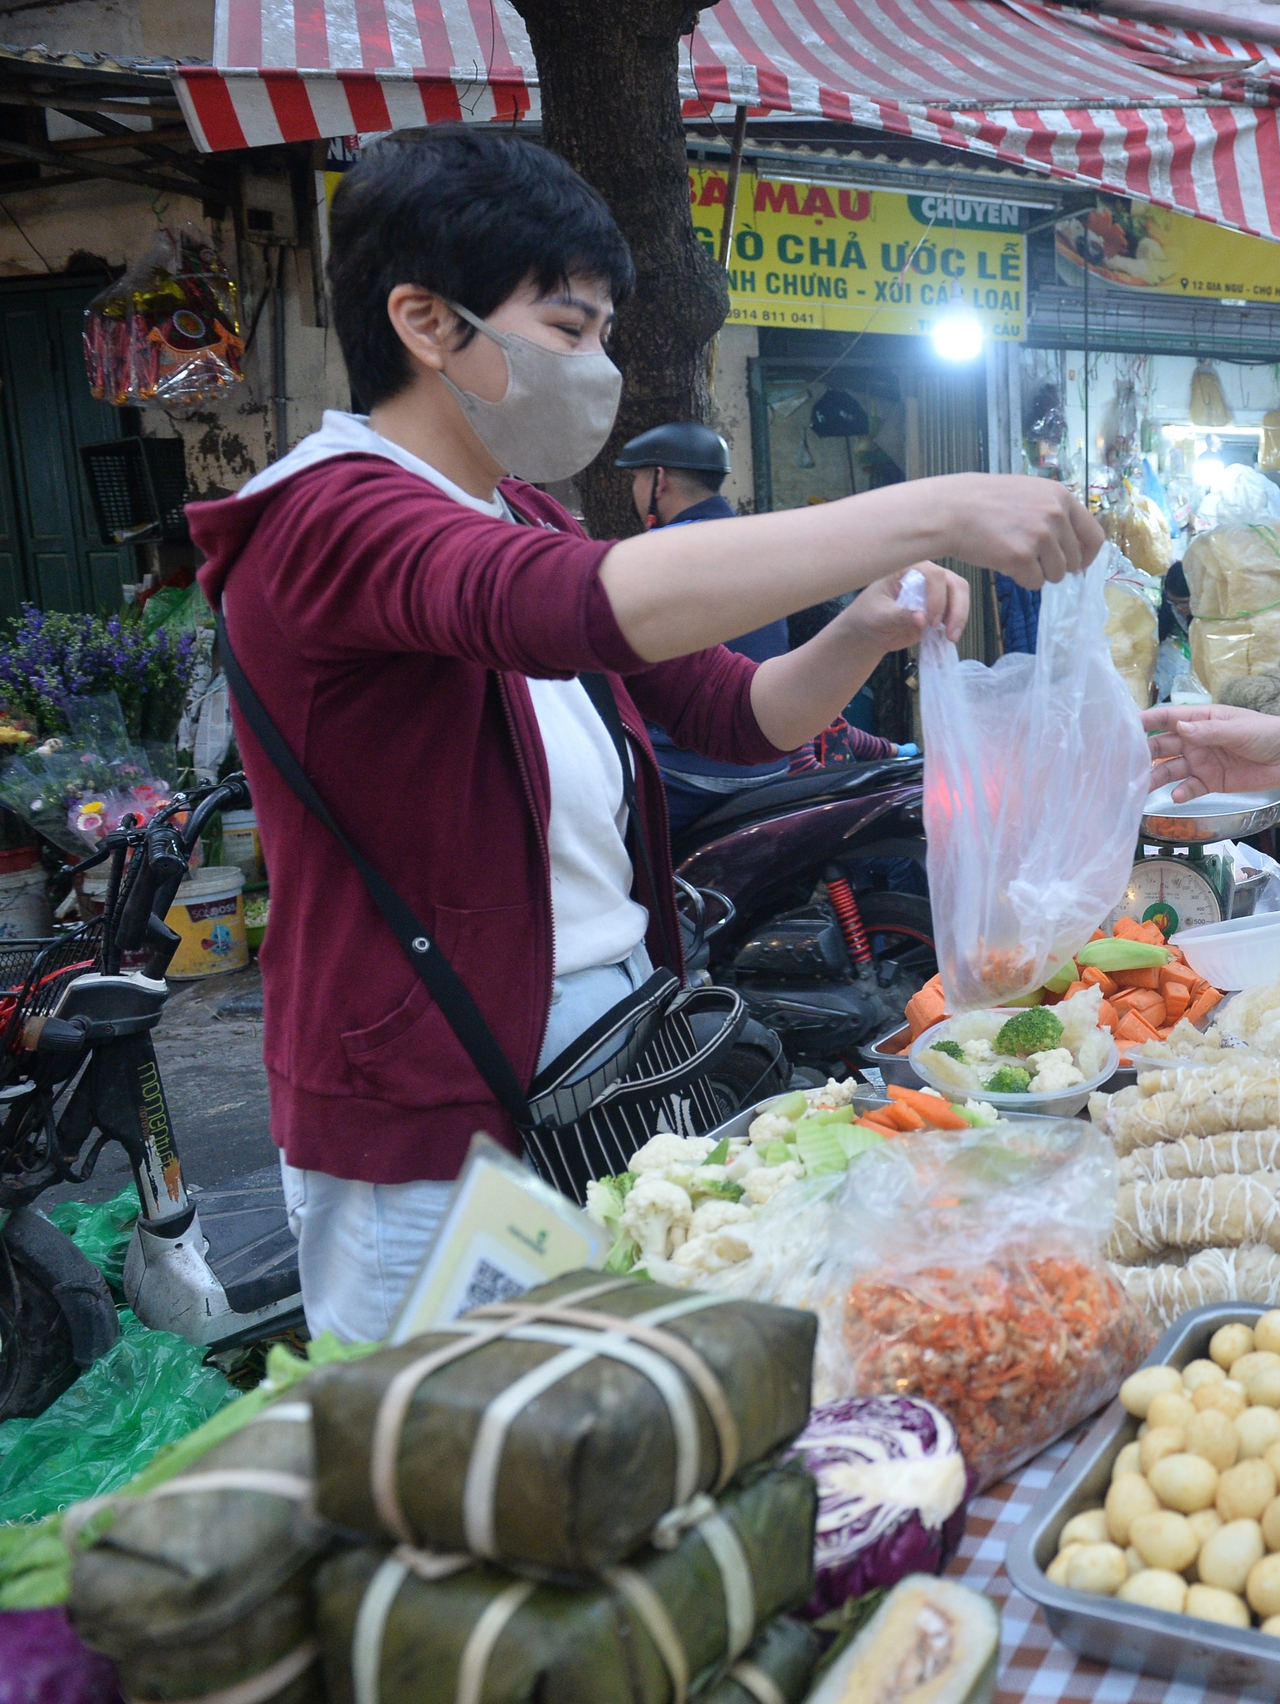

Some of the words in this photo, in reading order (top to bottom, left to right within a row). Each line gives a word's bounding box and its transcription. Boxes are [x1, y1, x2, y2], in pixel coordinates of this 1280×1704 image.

[754, 181, 871, 225] MẠU
[693, 223, 763, 261] GÒ
[777, 231, 867, 269] CHẢ
[977, 243, 1020, 281] LỄ
[766, 272, 847, 299] CHƯNG
[920, 281, 963, 306] CÁ
[973, 288, 1020, 316] LOẠI
[763, 310, 785, 322] 811
[791, 313, 814, 323] 041
[137, 1061, 175, 1175] momentum
